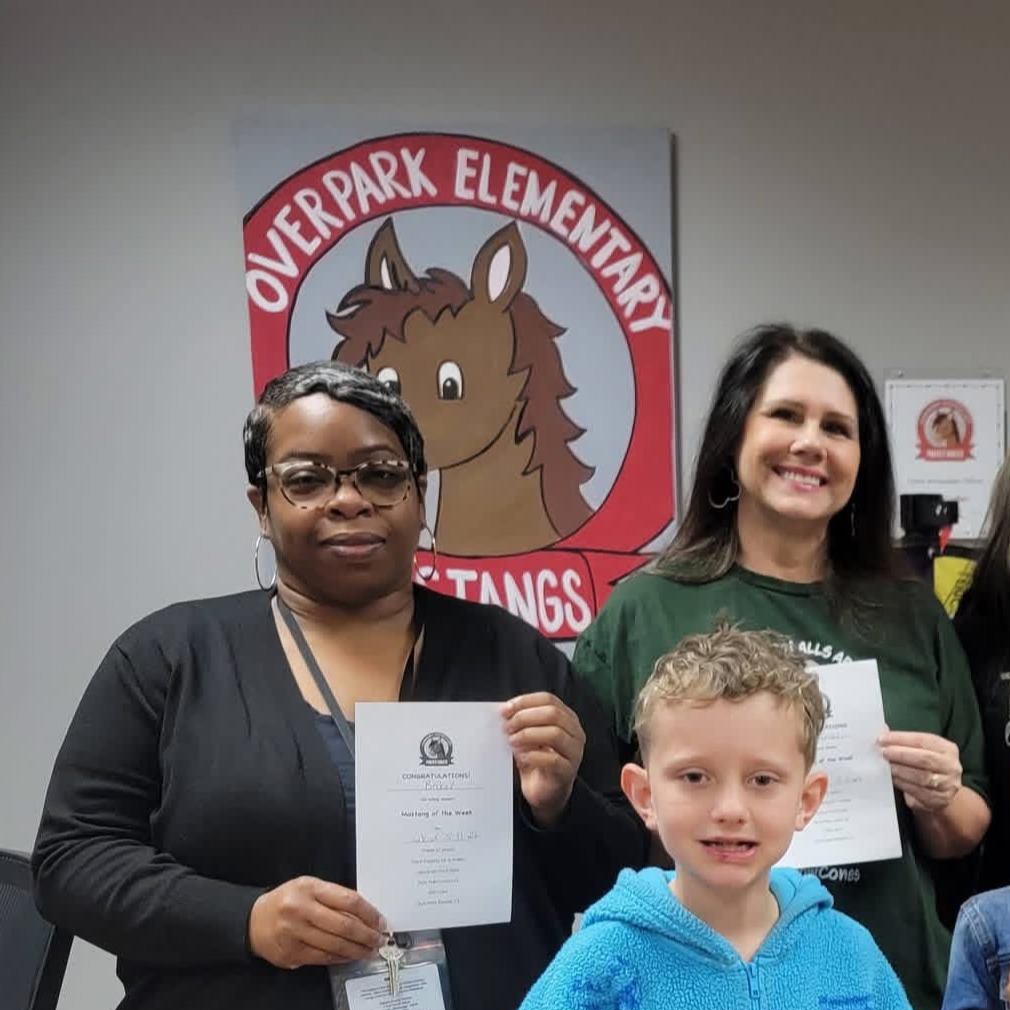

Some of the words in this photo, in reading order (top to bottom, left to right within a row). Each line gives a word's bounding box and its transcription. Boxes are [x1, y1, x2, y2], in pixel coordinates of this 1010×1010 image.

[246, 148, 437, 312] OVERPARK
[454, 149, 672, 334] ELEMENTARY
[416, 566, 592, 633] TANGS
